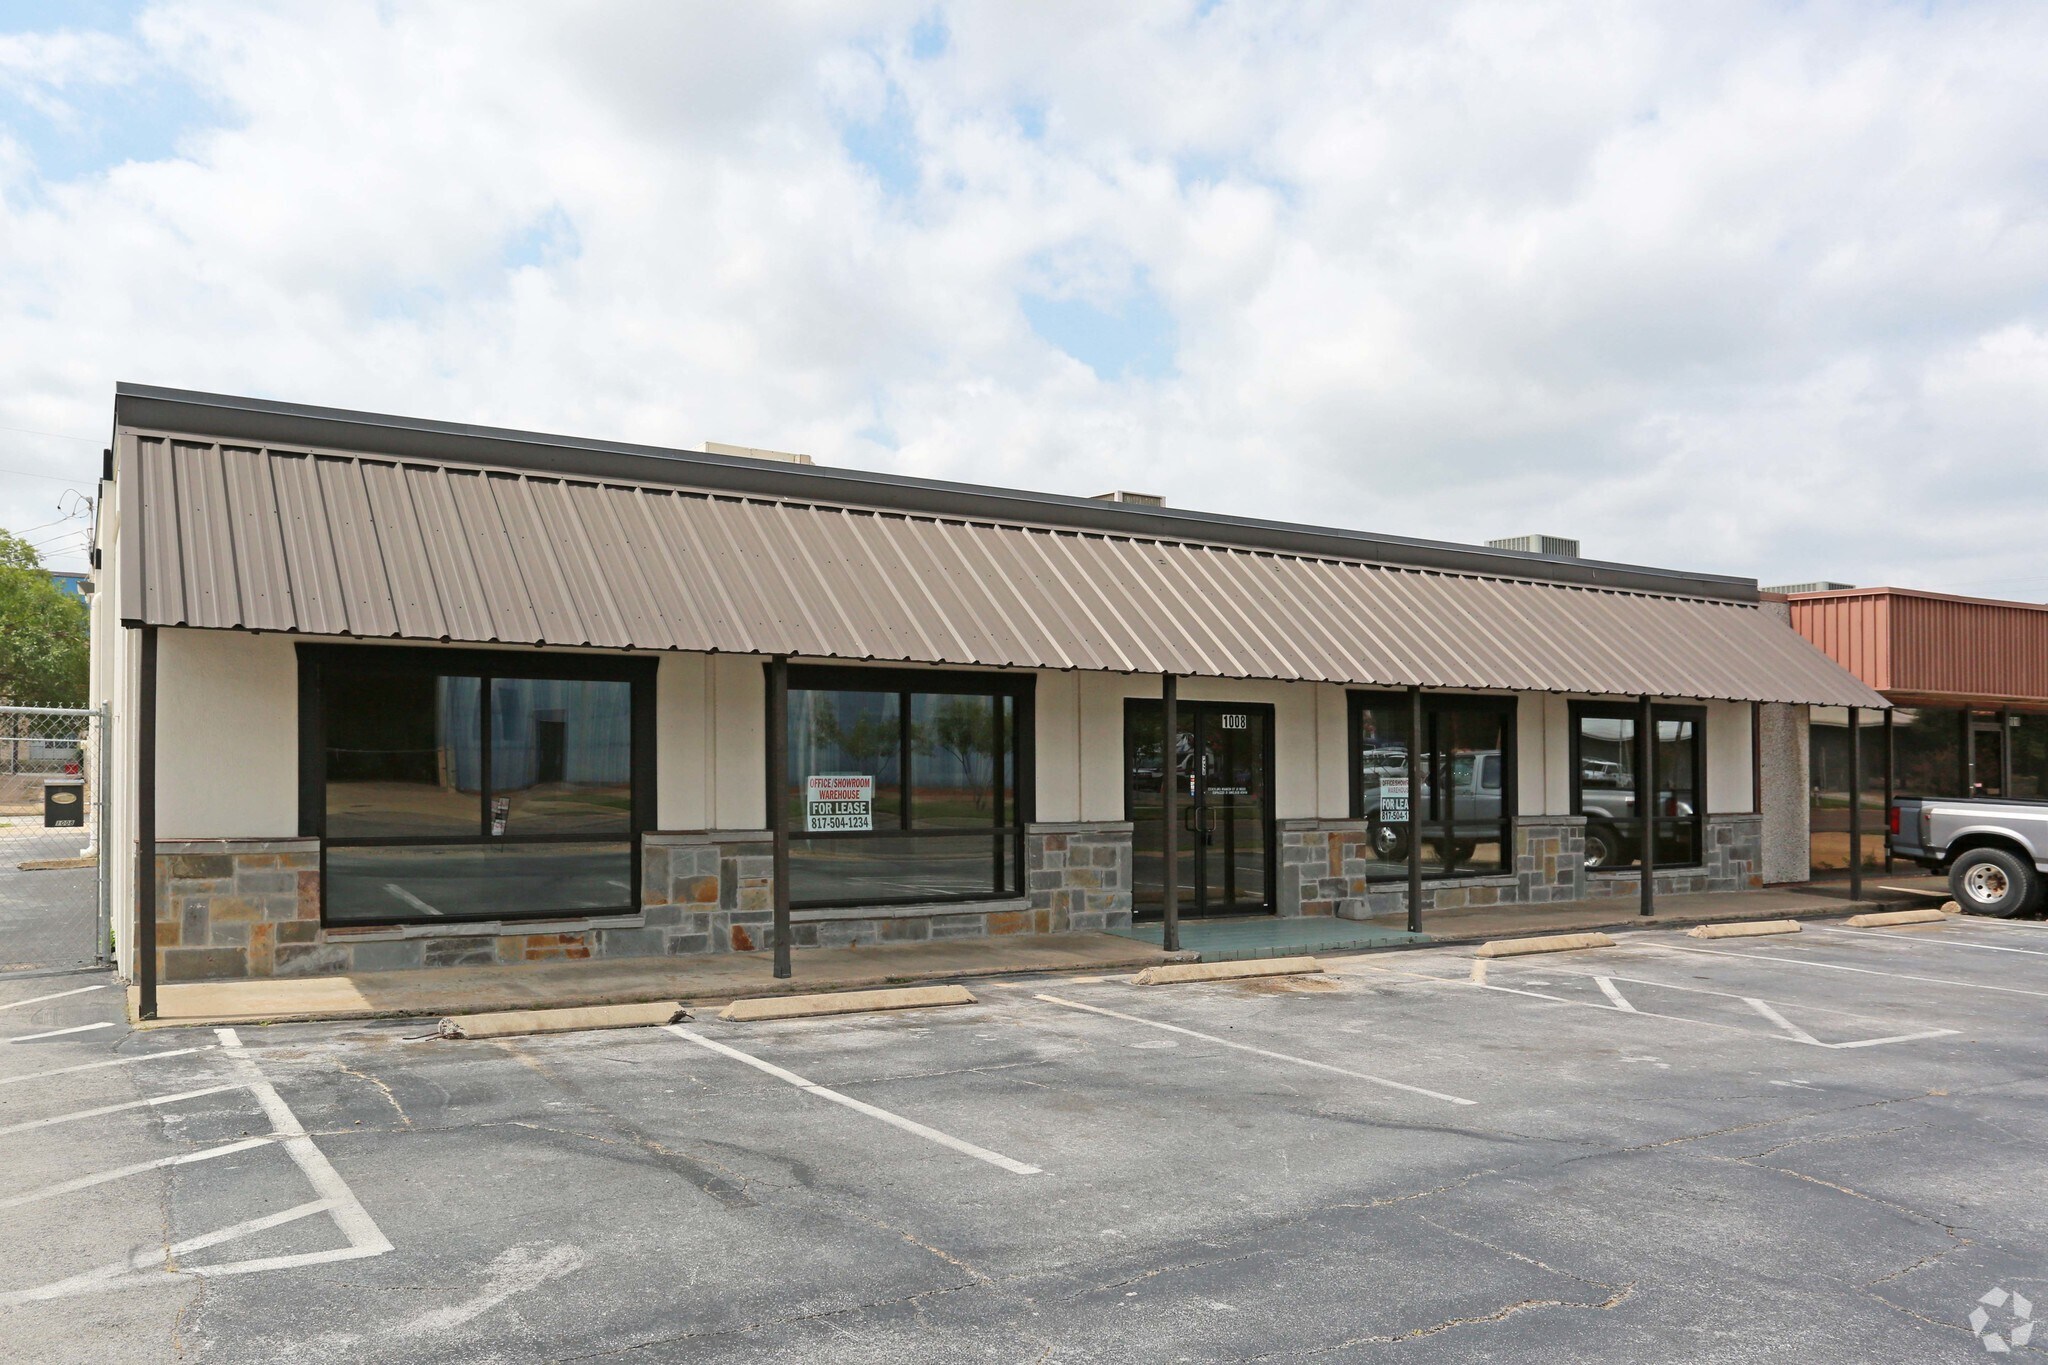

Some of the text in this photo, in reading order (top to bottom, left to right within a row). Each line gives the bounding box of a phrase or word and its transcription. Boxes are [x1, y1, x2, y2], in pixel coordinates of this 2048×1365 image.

[1223, 715, 1246, 727] 1008
[809, 778, 870, 789] OFFICE/SHOWROOM
[819, 790, 860, 800] WAREHOUSE
[812, 801, 867, 815] FOR LEASE
[1382, 798, 1409, 810] FOR LEA
[1382, 811, 1408, 820] 817-504-1
[811, 816, 869, 829] 817-504-1234
